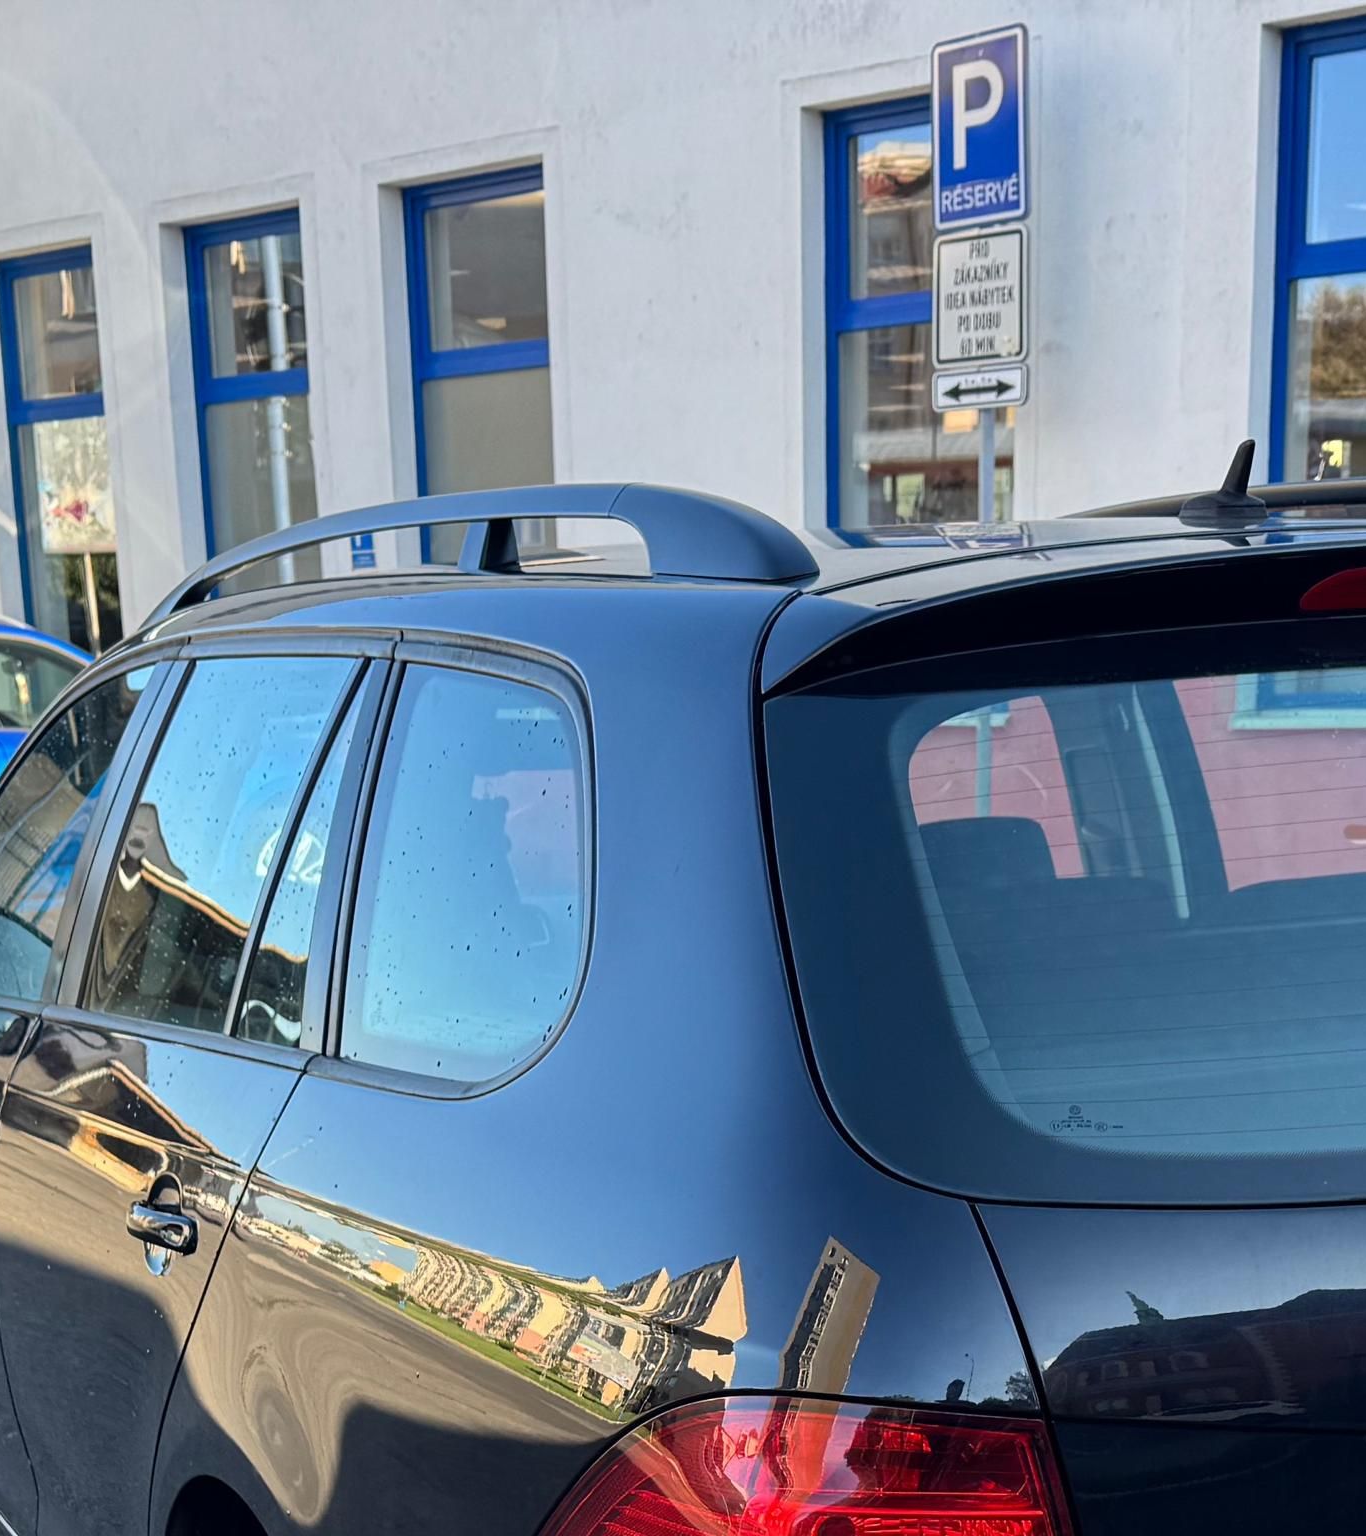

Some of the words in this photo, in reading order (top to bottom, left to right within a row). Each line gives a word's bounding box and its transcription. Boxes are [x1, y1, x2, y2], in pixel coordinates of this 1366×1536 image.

[953, 59, 1003, 170] P
[941, 173, 1019, 213] RÉSERVÉ
[969, 240, 990, 260] PRO
[953, 259, 1010, 286] ZÁKAZNÍKY
[944, 291, 968, 311] IDEA
[968, 286, 1015, 308] NÁBYTEK
[957, 314, 972, 333] PO
[972, 311, 1002, 331] DOBU
